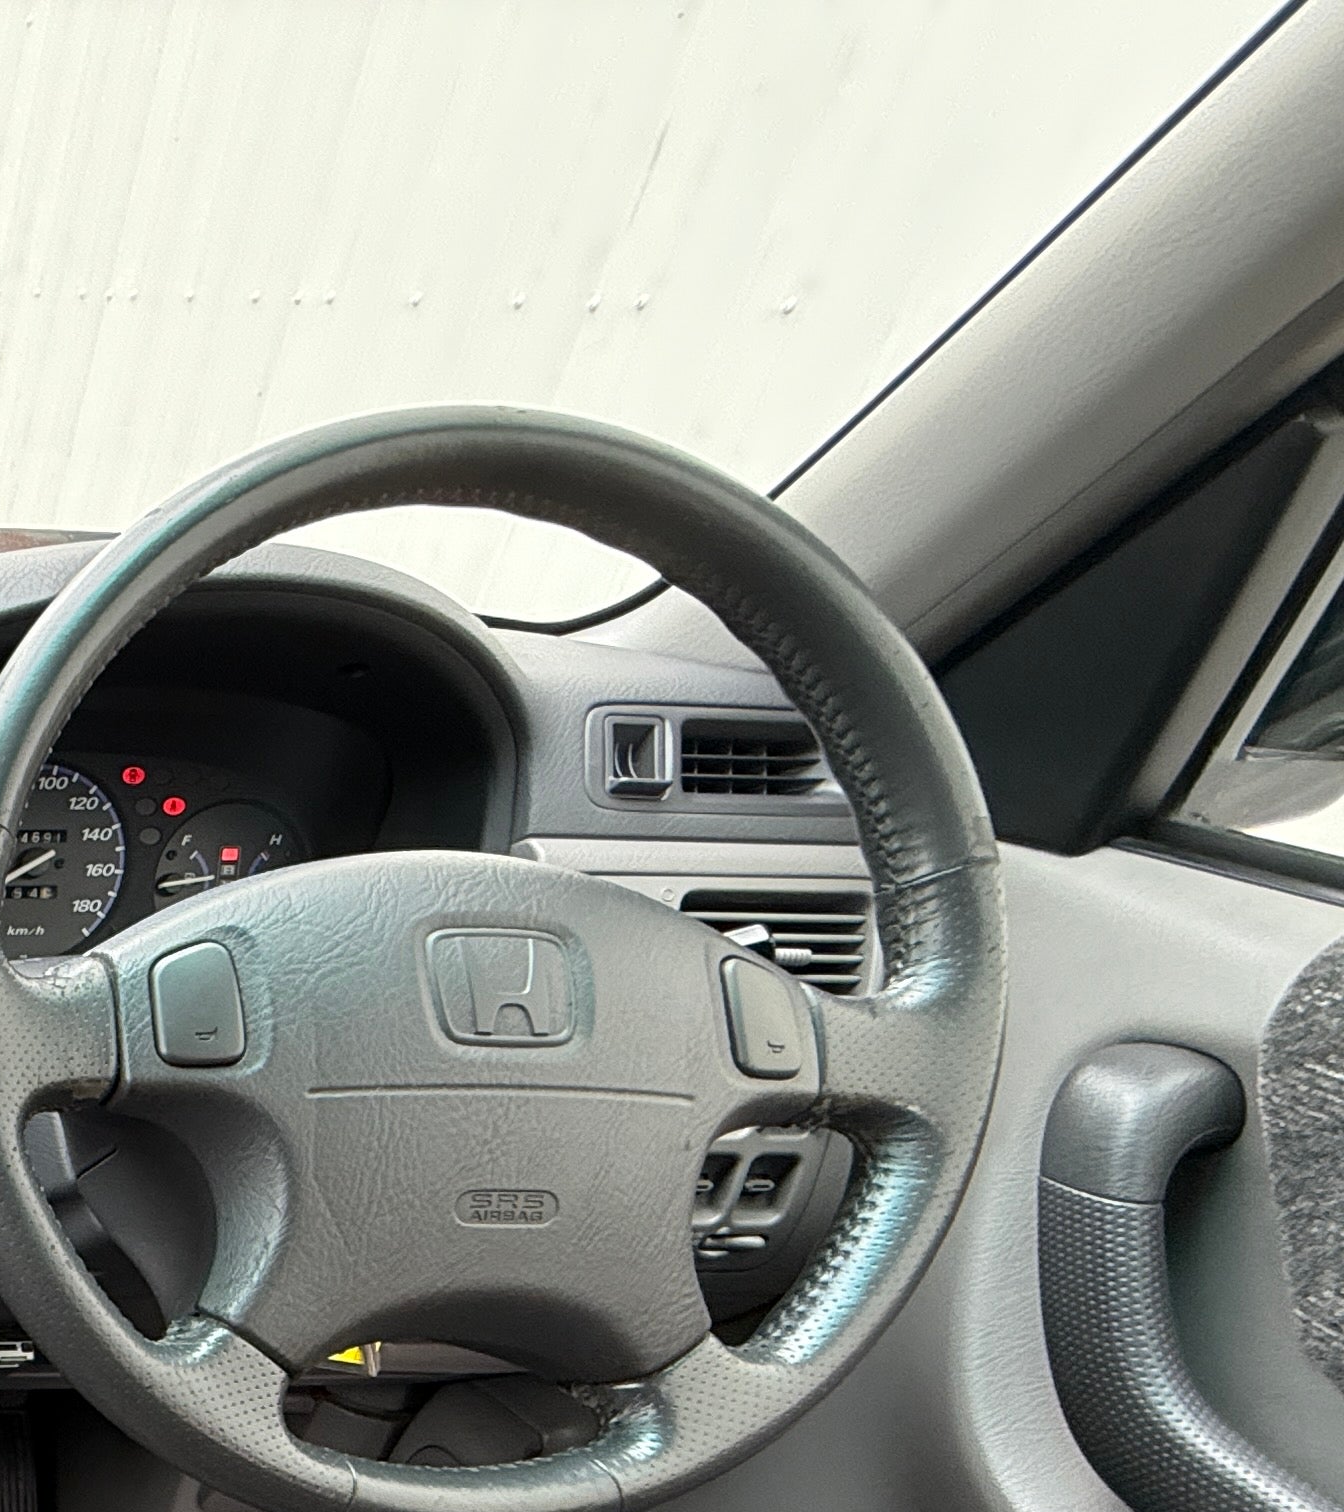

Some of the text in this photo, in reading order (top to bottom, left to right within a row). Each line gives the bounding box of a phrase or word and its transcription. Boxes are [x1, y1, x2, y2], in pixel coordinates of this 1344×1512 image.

[38, 776, 69, 790] 100
[69, 797, 99, 811] 120
[81, 827, 112, 842] 140
[181, 834, 193, 847] F
[269, 833, 283, 846] H
[86, 863, 115, 877] 160
[72, 899, 102, 913] 180
[7, 925, 45, 936] km/h
[470, 1193, 544, 1209] SRS
[471, 1210, 543, 1221] AIRBAG
